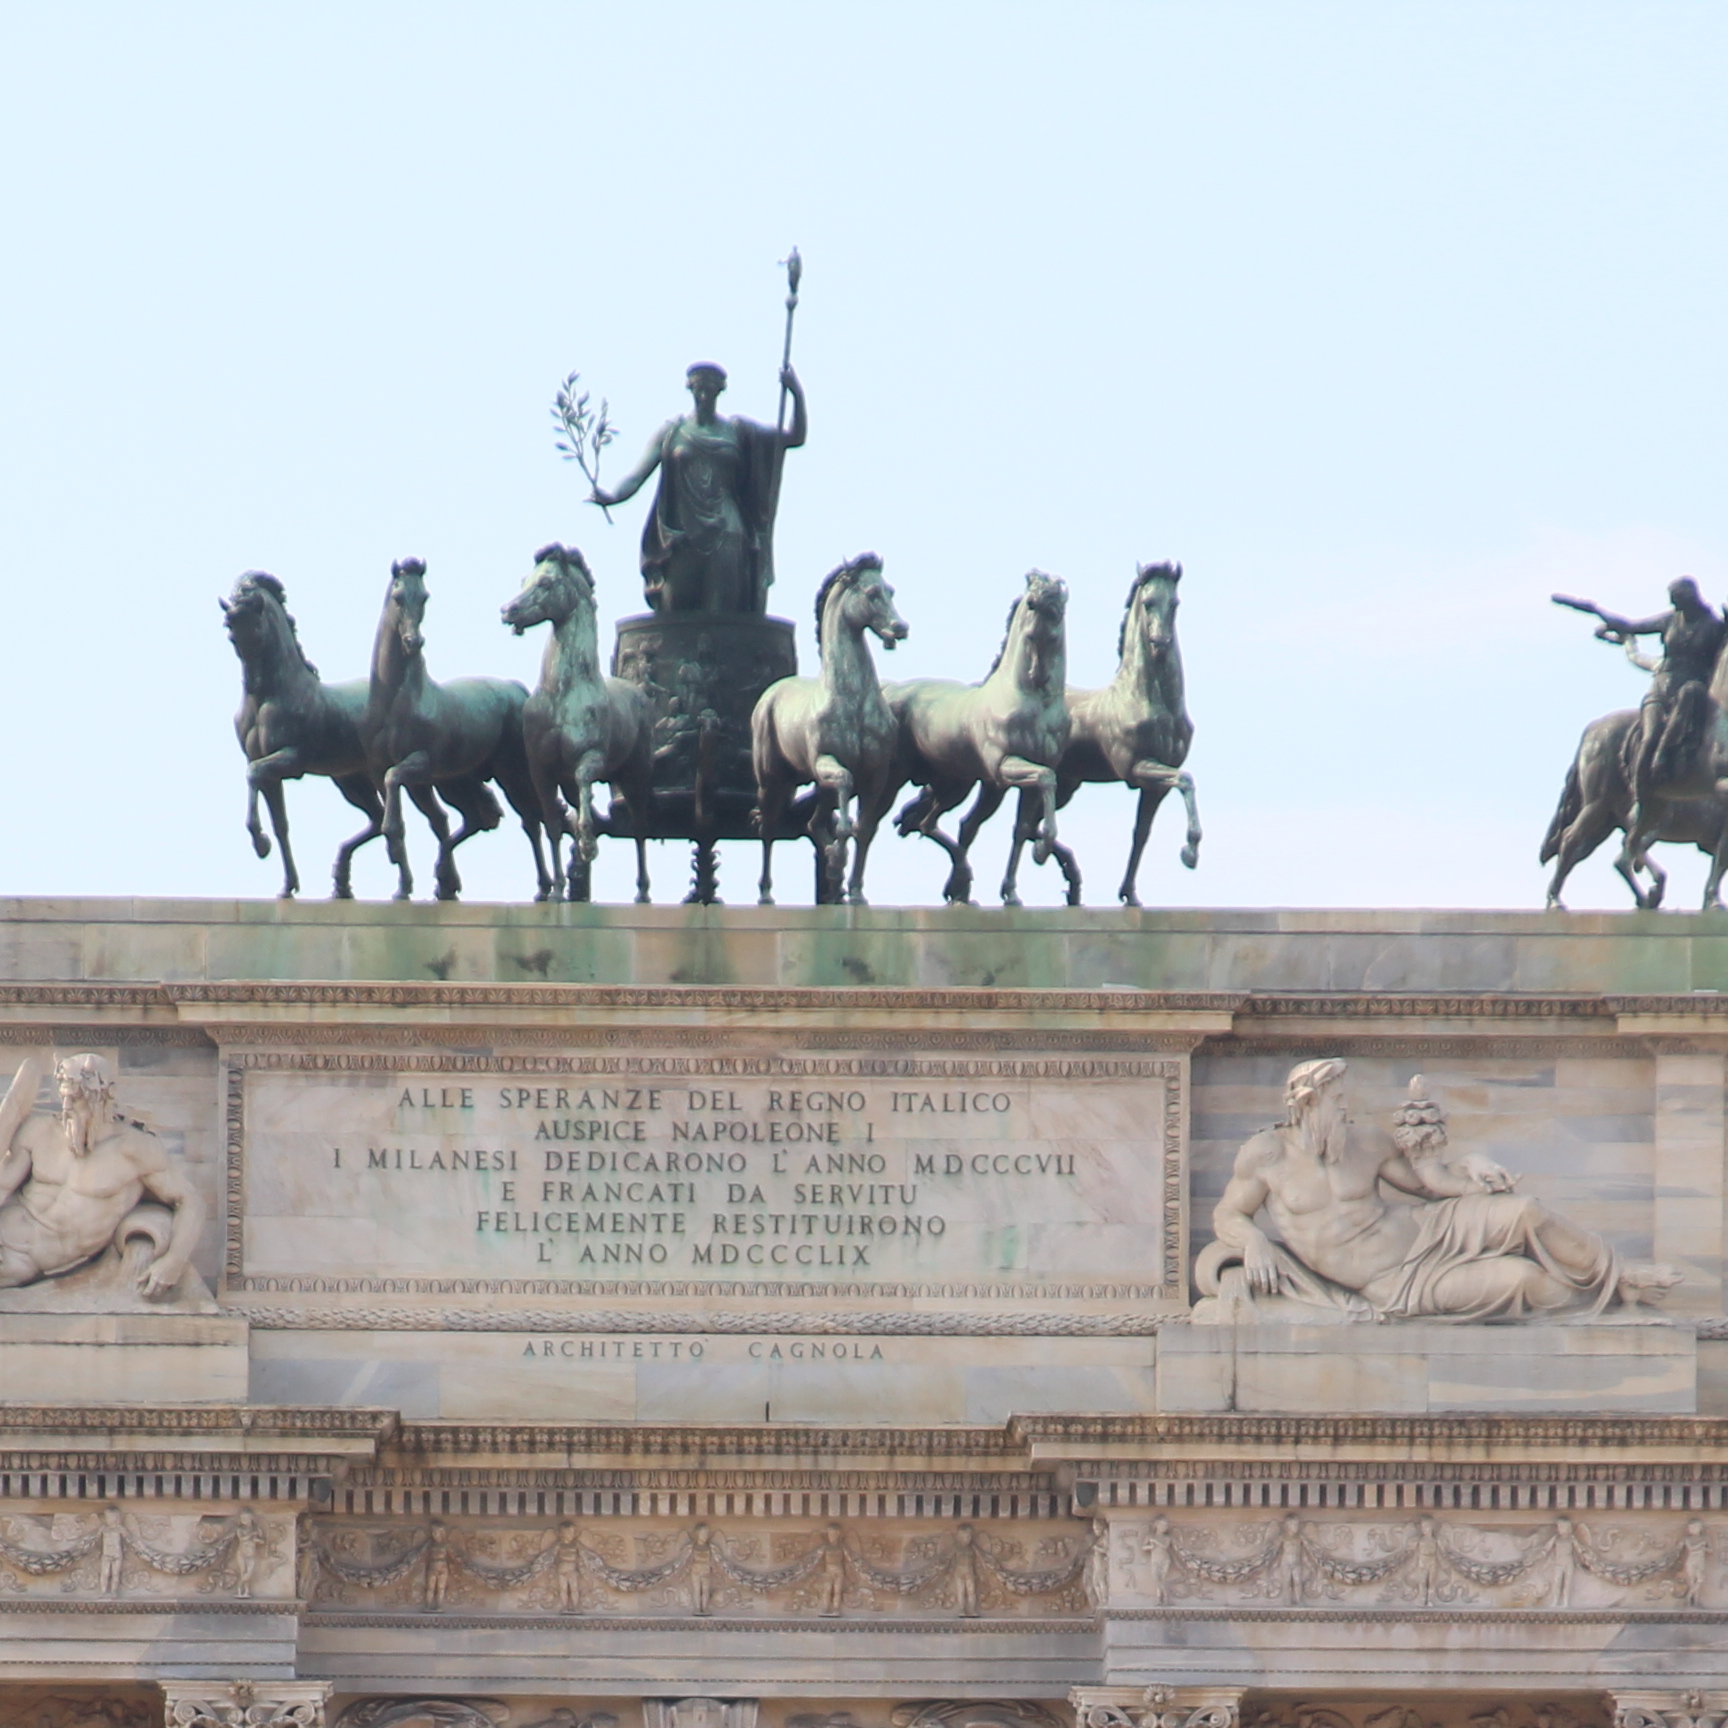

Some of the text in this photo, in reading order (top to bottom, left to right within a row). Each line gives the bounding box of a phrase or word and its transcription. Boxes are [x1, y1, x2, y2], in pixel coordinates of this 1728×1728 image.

[398, 1087, 1011, 1113] ALLE SPERANZE DEL REGNO ITALICO
[535, 1120, 874, 1144] AUSPICE NAPOLEONE I
[333, 1148, 341, 1169] I
[367, 1149, 518, 1171] MILANESI
[545, 1151, 747, 1174] DEDICARONO
[805, 1154, 886, 1174] ANNO
[914, 1154, 1076, 1176] MDCCCVII
[502, 1181, 918, 1206] E FRANCATI DA SERVITU
[476, 1211, 946, 1236] FELICEMENTE RESTITUIRONO
[579, 1243, 668, 1264] ANNO
[692, 1244, 870, 1266] MDCCCLIX
[749, 1342, 884, 1360] CAGNOLA
